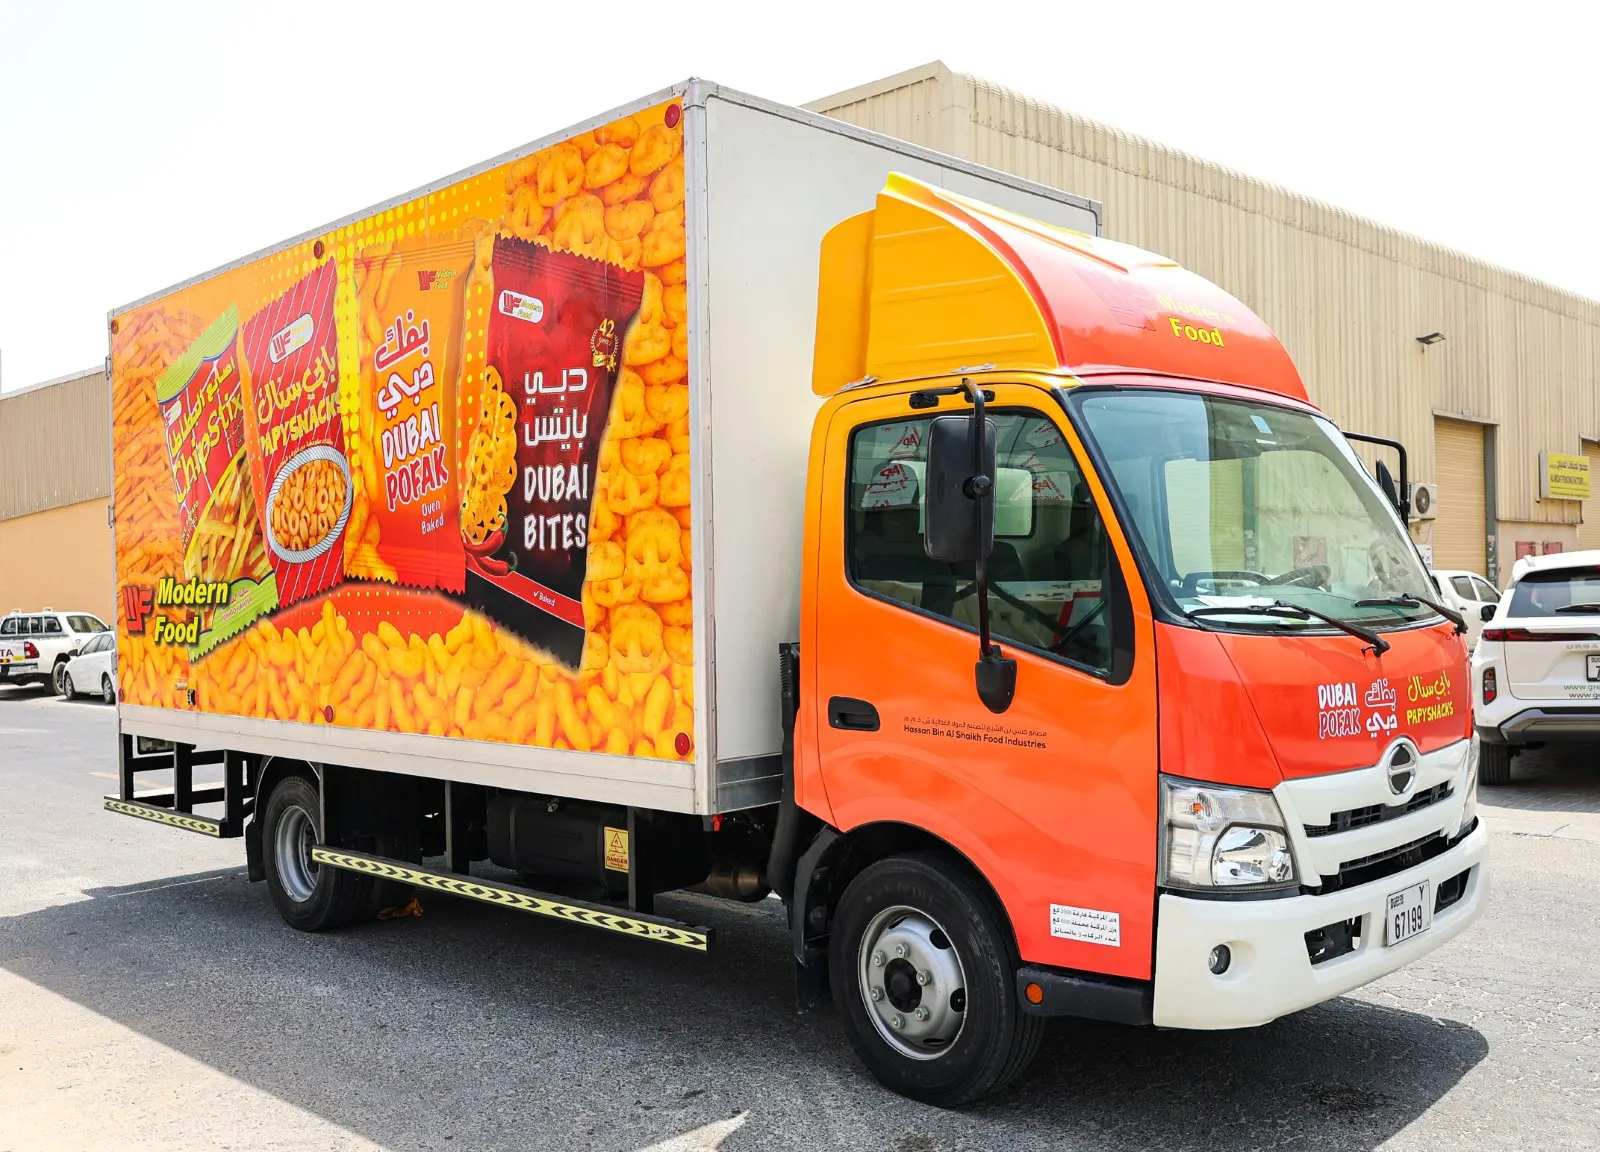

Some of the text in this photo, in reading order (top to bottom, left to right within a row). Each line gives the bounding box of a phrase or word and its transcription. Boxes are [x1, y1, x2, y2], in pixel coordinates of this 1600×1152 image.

[599, 318, 615, 338] 42
[1168, 316, 1225, 348] Food
[377, 360, 436, 420] دبي
[524, 366, 589, 405] دبي
[381, 403, 442, 468] DUBAI
[385, 443, 450, 512] POFAK
[523, 463, 589, 503] DUBAI
[421, 500, 441, 517] Oven
[421, 518, 445, 535] Baked
[523, 511, 588, 551] BITES
[157, 577, 229, 605] Modern
[538, 591, 556, 607] Baked
[154, 616, 199, 643] Food
[1317, 682, 1357, 709] DUBAI
[1318, 707, 1361, 740] POFAK
[1365, 711, 1398, 739] دبي
[1406, 700, 1454, 726] PAPYSNACKS
[903, 724, 1047, 749] Hassan Bin Al Shaikh Food Industries
[1419, 885, 1425, 901] Y
[1394, 905, 1423, 940] 67199
